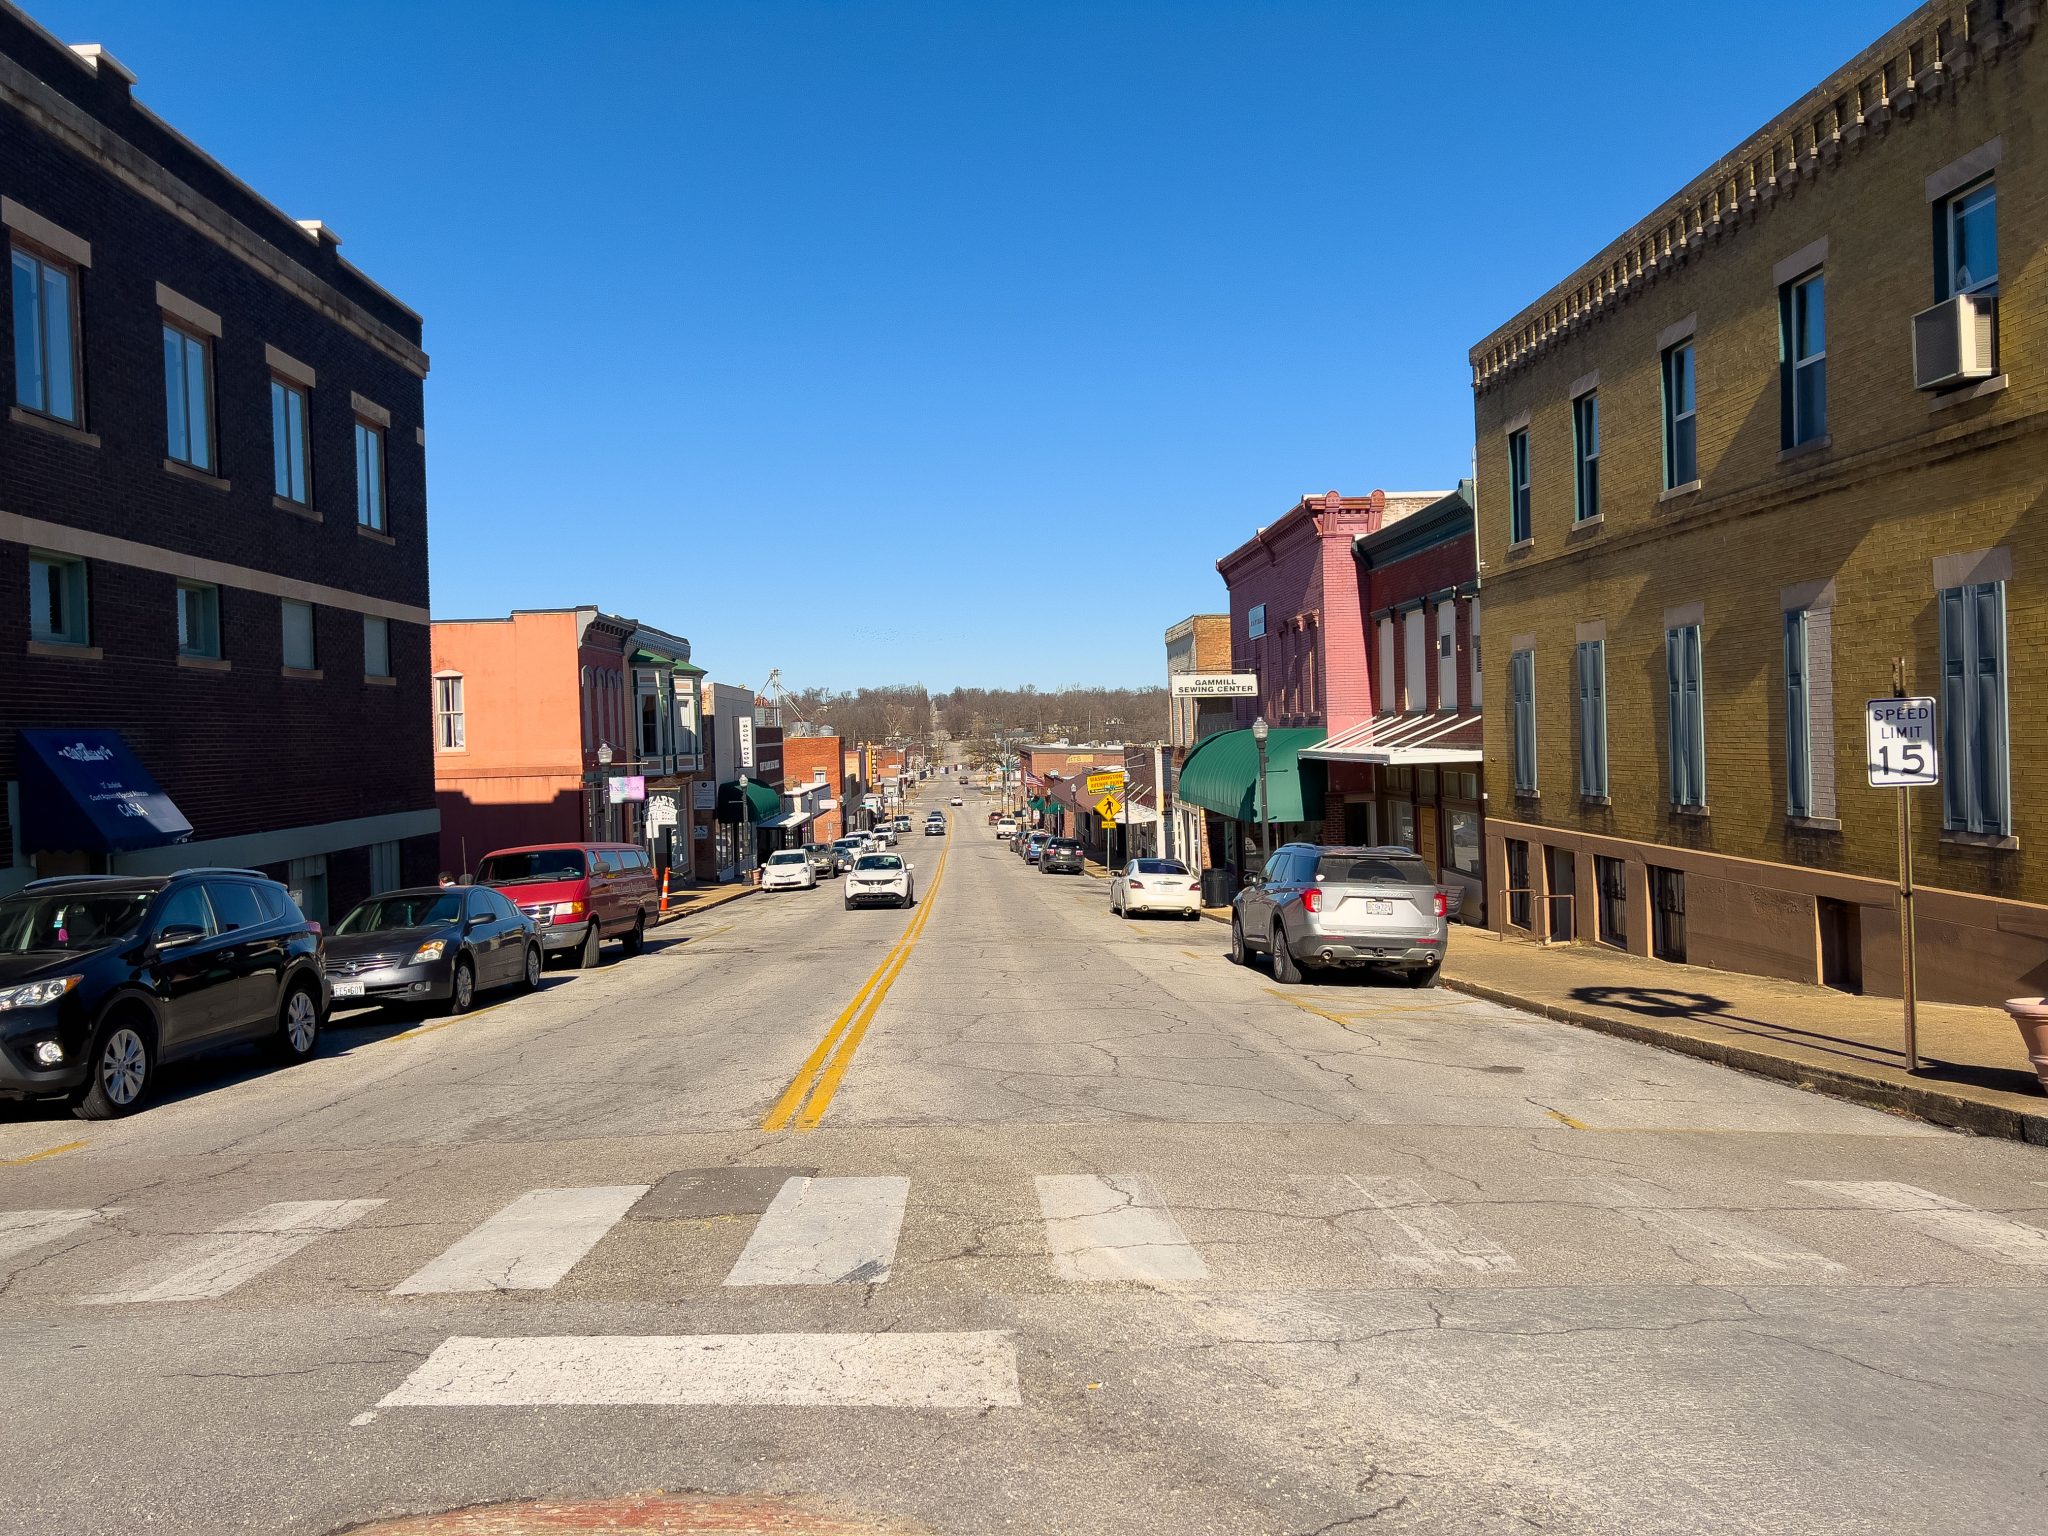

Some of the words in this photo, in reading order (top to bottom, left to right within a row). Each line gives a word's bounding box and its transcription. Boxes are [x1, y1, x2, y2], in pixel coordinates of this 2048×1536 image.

[1874, 707, 1928, 721] SPEED
[1882, 726, 1922, 739] LIMIT
[1878, 744, 1925, 776] 15
[643, 795, 676, 809] OZARK
[117, 802, 149, 817] CASA
